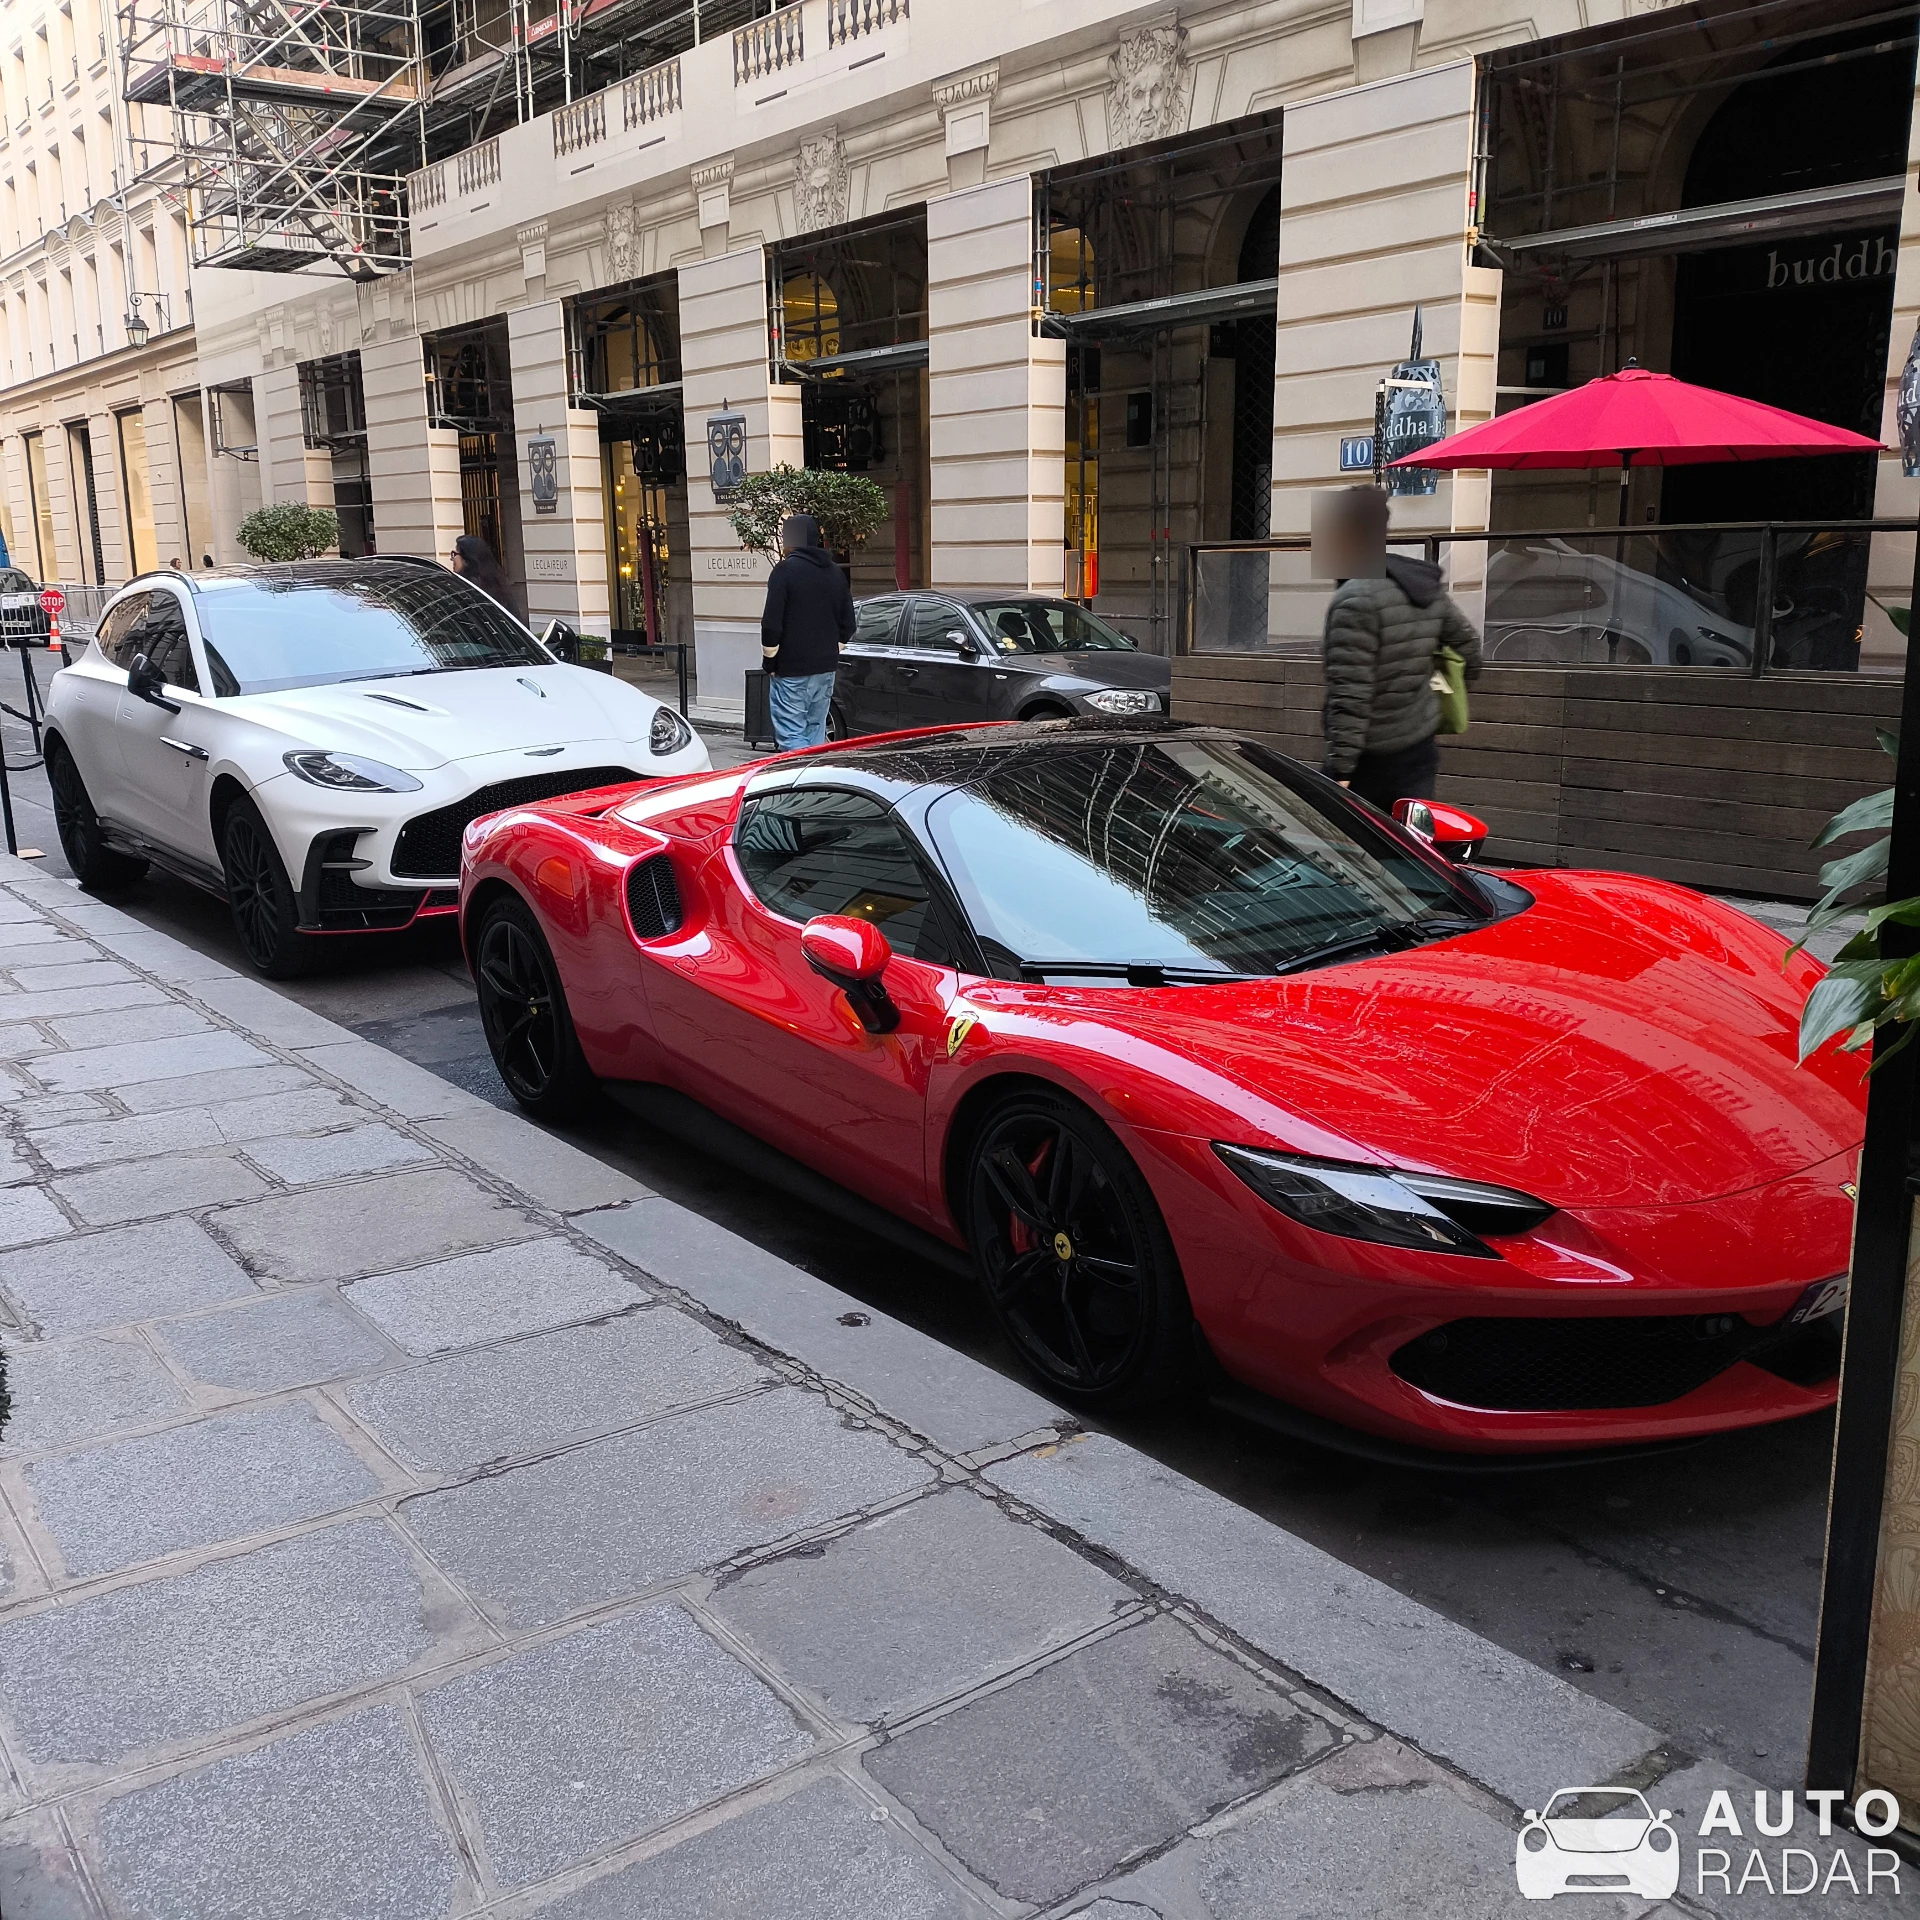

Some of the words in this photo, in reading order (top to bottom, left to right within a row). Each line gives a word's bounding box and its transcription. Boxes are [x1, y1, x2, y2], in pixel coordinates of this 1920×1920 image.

[1546, 310, 1562, 325] 10
[1345, 440, 1369, 466] 10
[532, 559, 568, 570] LECLAIREUR
[707, 557, 758, 570] LECLAIREUR
[41, 596, 64, 607] STOP
[1791, 1308, 1807, 1322] B
[1808, 1285, 1847, 1316] 2-
